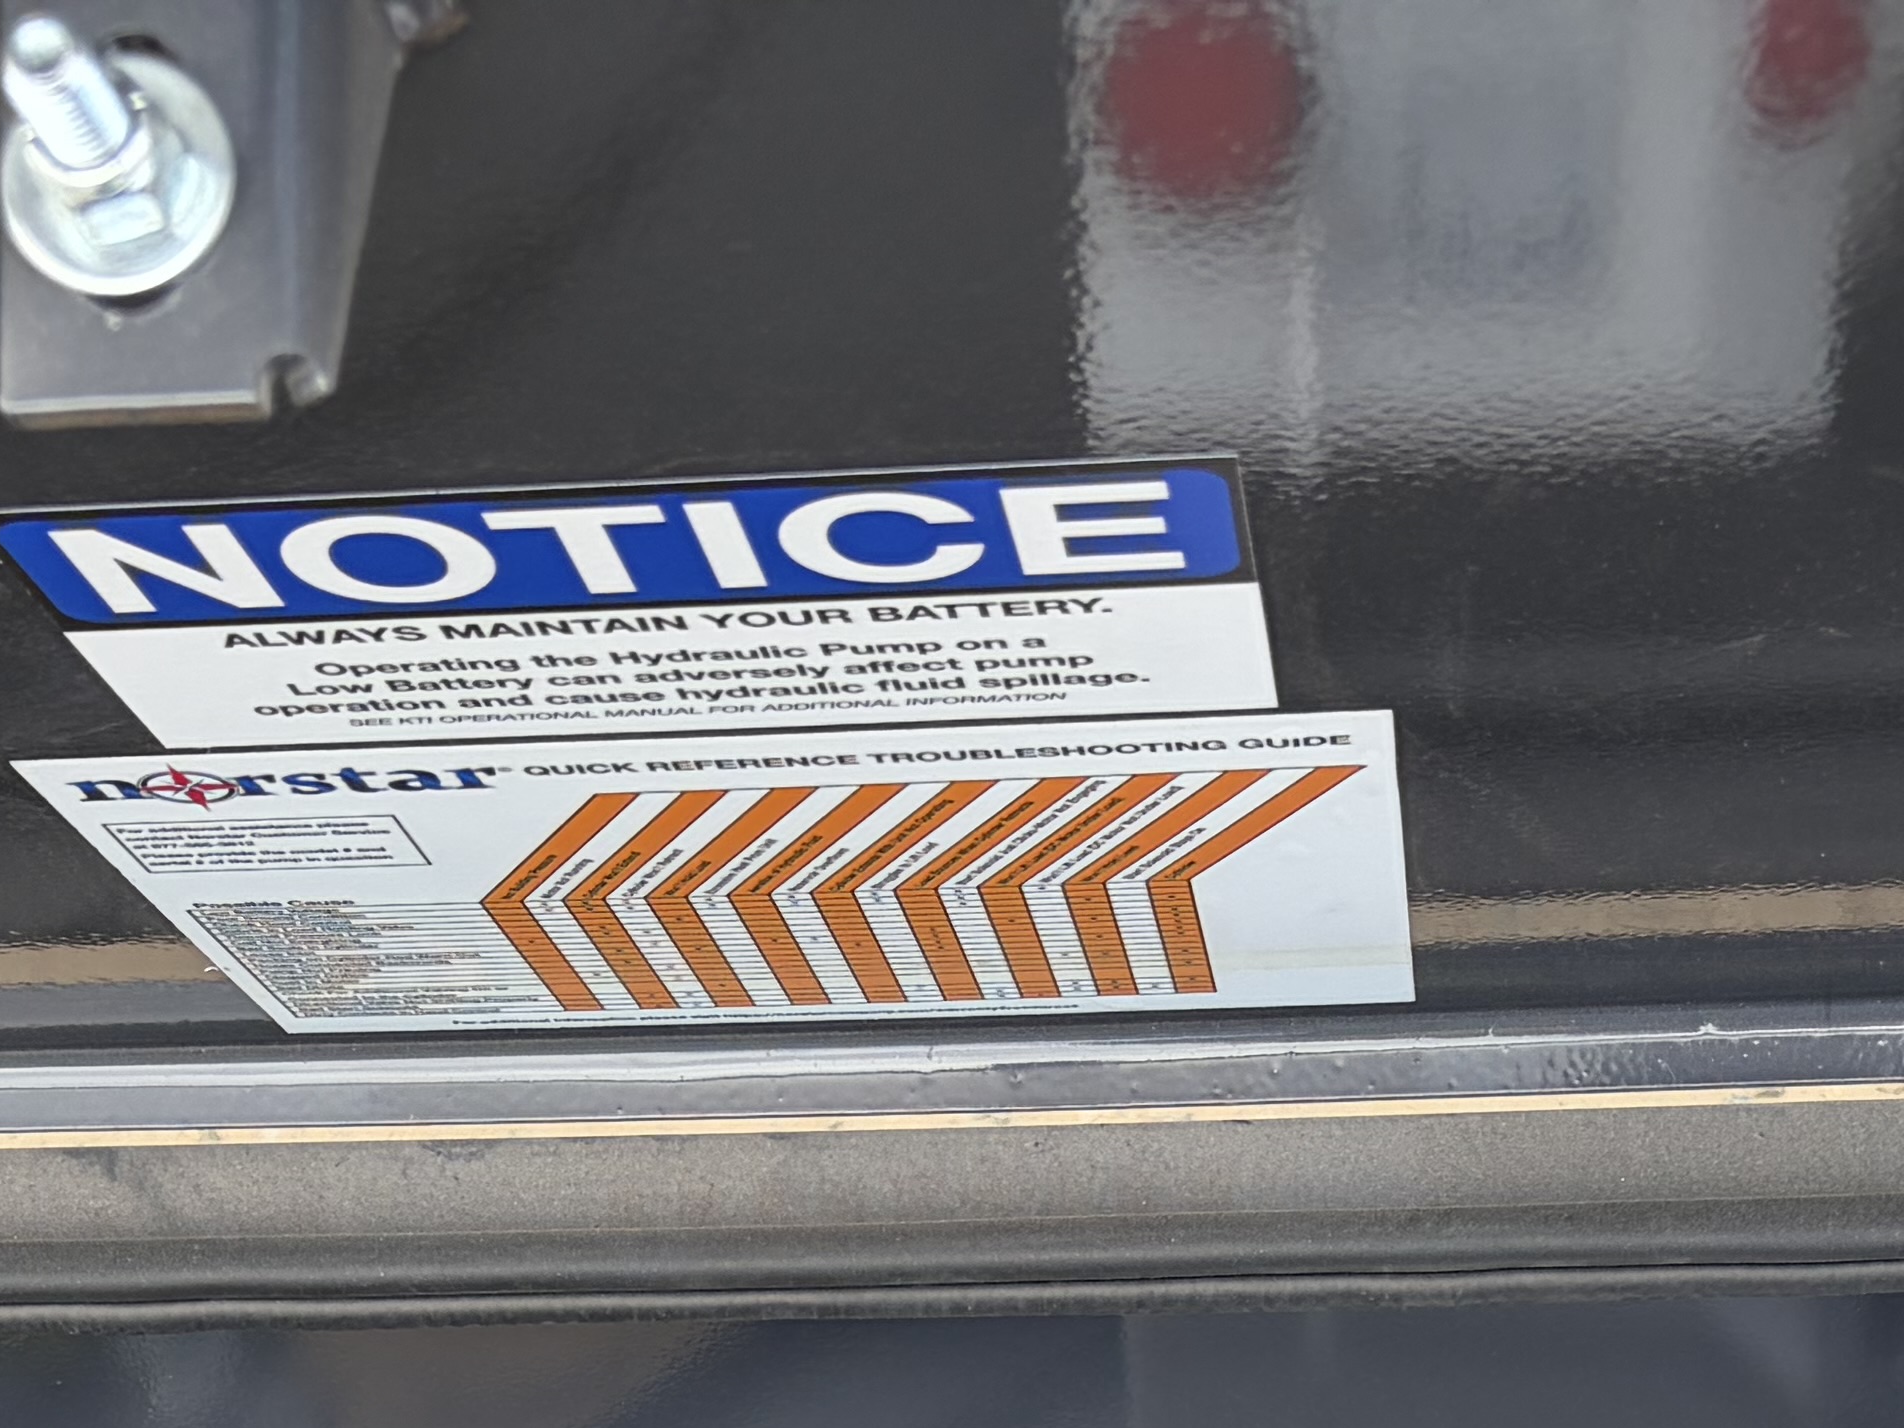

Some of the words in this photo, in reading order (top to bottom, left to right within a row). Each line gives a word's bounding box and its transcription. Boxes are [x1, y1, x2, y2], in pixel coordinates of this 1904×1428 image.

[48, 480, 1187, 614] NOTICE
[223, 623, 428, 649] ALWAYS
[439, 614, 687, 642] MAINTAIN
[699, 606, 852, 631] YOUR
[868, 598, 1112, 624] BATTERY.
[287, 681, 373, 697] Low
[383, 674, 533, 695] Battery
[547, 672, 620, 687] can
[634, 662, 850, 685] adversely
[858, 659, 966, 676] affect
[975, 654, 1095, 673] pump
[315, 655, 521, 678] Operating
[529, 653, 596, 669] the
[604, 643, 807, 669] Hydraulic
[819, 638, 943, 659] Pump
[957, 638, 1007, 652] on
[1022, 636, 1047, 648] a
[254, 697, 449, 718] operation
[459, 695, 533, 709] and
[544, 689, 667, 707] cause
[675, 679, 863, 703] hydraulic
[876, 676, 965, 692] fluid
[977, 670, 1151, 692] spillage.
[349, 717, 395, 728] SEE
[438, 711, 599, 724] OPERATIONAL
[604, 706, 702, 719] MANUAL
[709, 704, 755, 716] FOR
[762, 698, 900, 713] ADDITIONAL
[905, 691, 1067, 707] INFORMATION
[66, 764, 497, 810] norstar
[524, 762, 639, 777] QUICK
[646, 754, 860, 773] REFERENCE
[866, 739, 1227, 764] TROUBLESHOOTING
[1238, 734, 1352, 750] GUIDE
